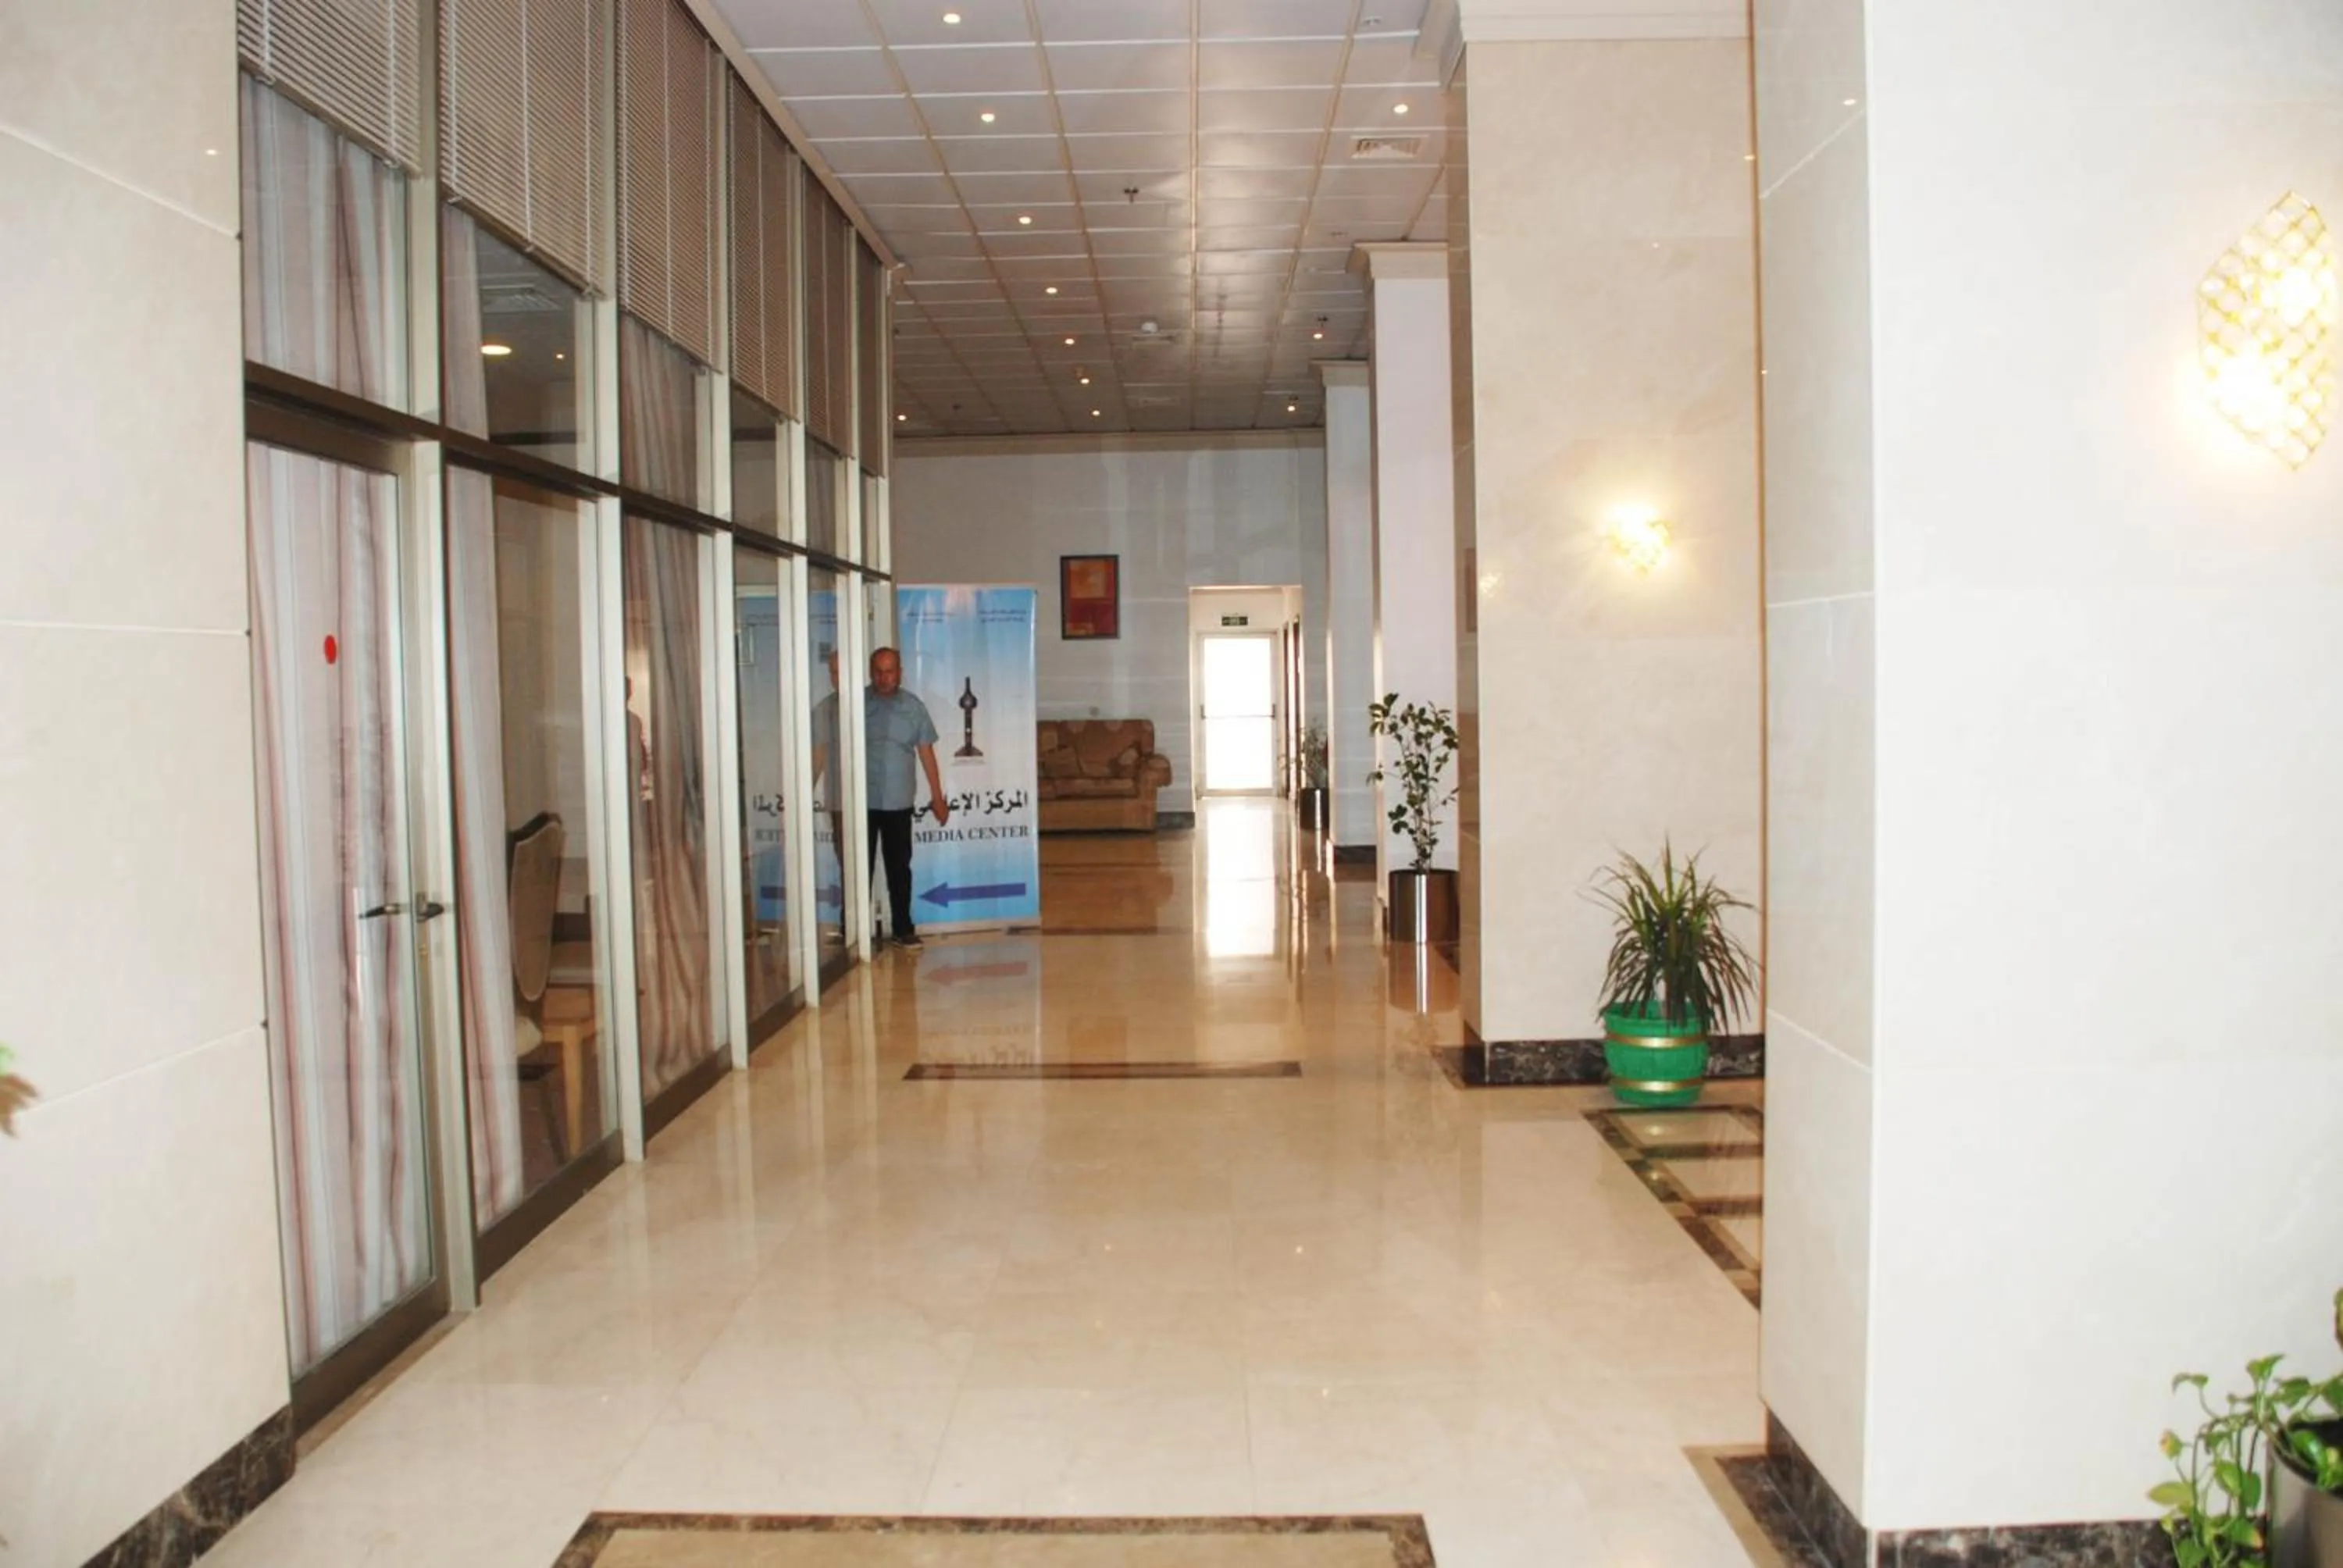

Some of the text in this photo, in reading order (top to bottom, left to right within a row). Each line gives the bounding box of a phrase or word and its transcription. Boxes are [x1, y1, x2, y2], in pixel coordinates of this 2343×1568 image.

[984, 789, 1029, 814] المركز
[914, 825, 1029, 843] MEDIA CENTER
